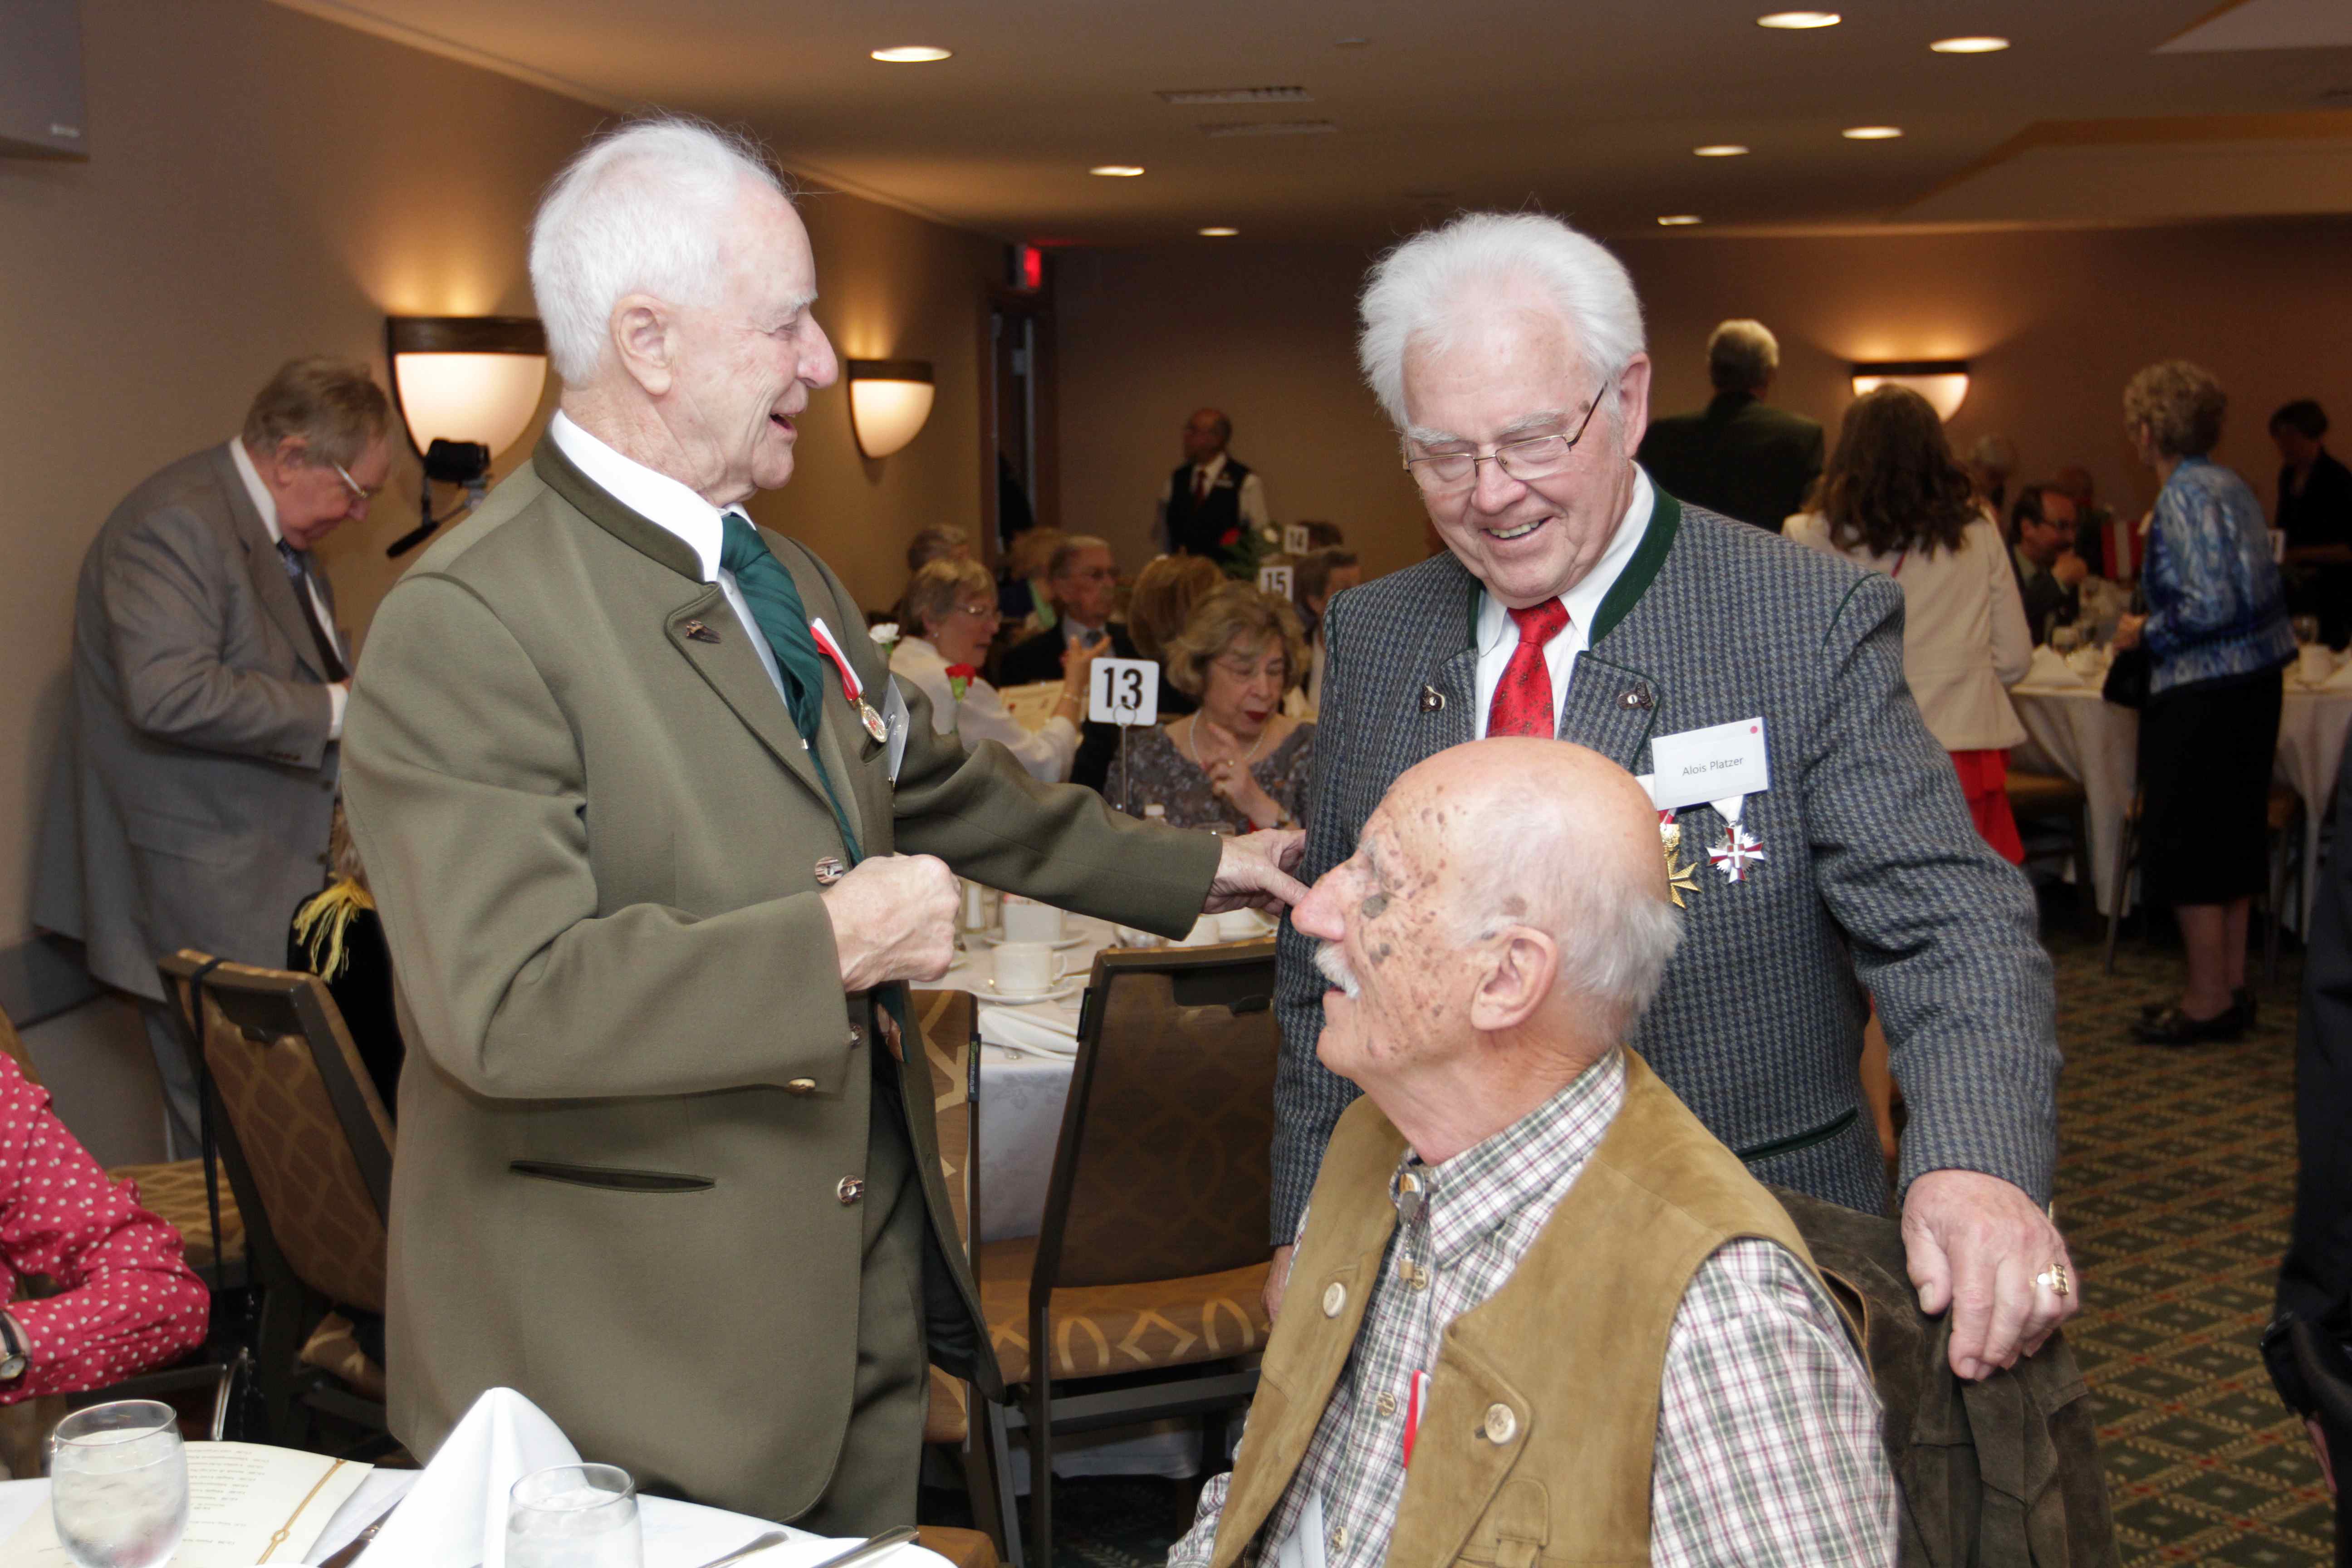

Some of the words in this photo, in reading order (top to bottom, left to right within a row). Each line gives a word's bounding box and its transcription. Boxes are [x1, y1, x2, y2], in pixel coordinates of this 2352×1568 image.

[1267, 572, 1285, 593] 15
[1103, 666, 1142, 710] 13
[1682, 763, 1706, 776] Alois
[1710, 757, 1743, 770] Platzer
